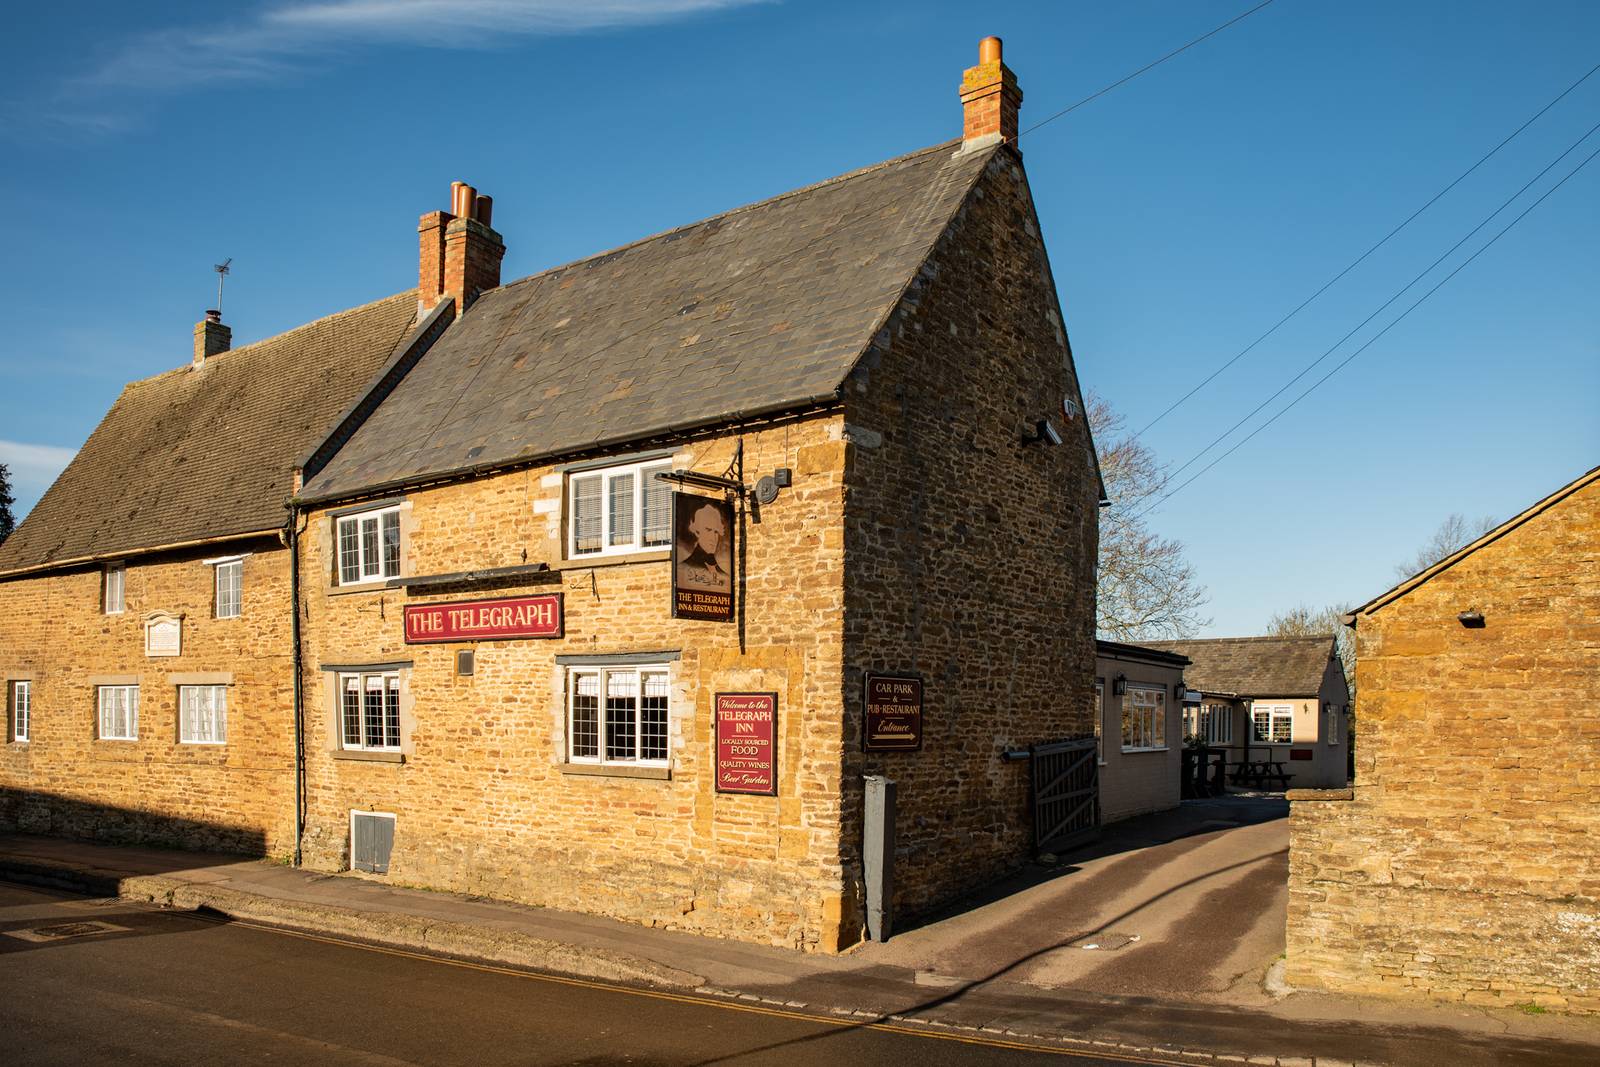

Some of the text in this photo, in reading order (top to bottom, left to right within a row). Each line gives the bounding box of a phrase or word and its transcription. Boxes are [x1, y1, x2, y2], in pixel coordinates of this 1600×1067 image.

[678, 593, 730, 605] THE TELEGRAPH
[693, 604, 729, 614] RESTAURANT
[409, 603, 553, 632] THE TELEGRAPH
[876, 683, 913, 694] CAR PARK
[892, 695, 898, 703] &
[721, 700, 768, 709] Welcome to the
[719, 711, 772, 720] TELEGRAPH
[736, 723, 754, 733] INN
[877, 720, 910, 732] Entrance
[731, 746, 758, 755] FOOD
[720, 760, 770, 769] QUALITY WINES
[720, 772, 769, 785] Beer Garden
